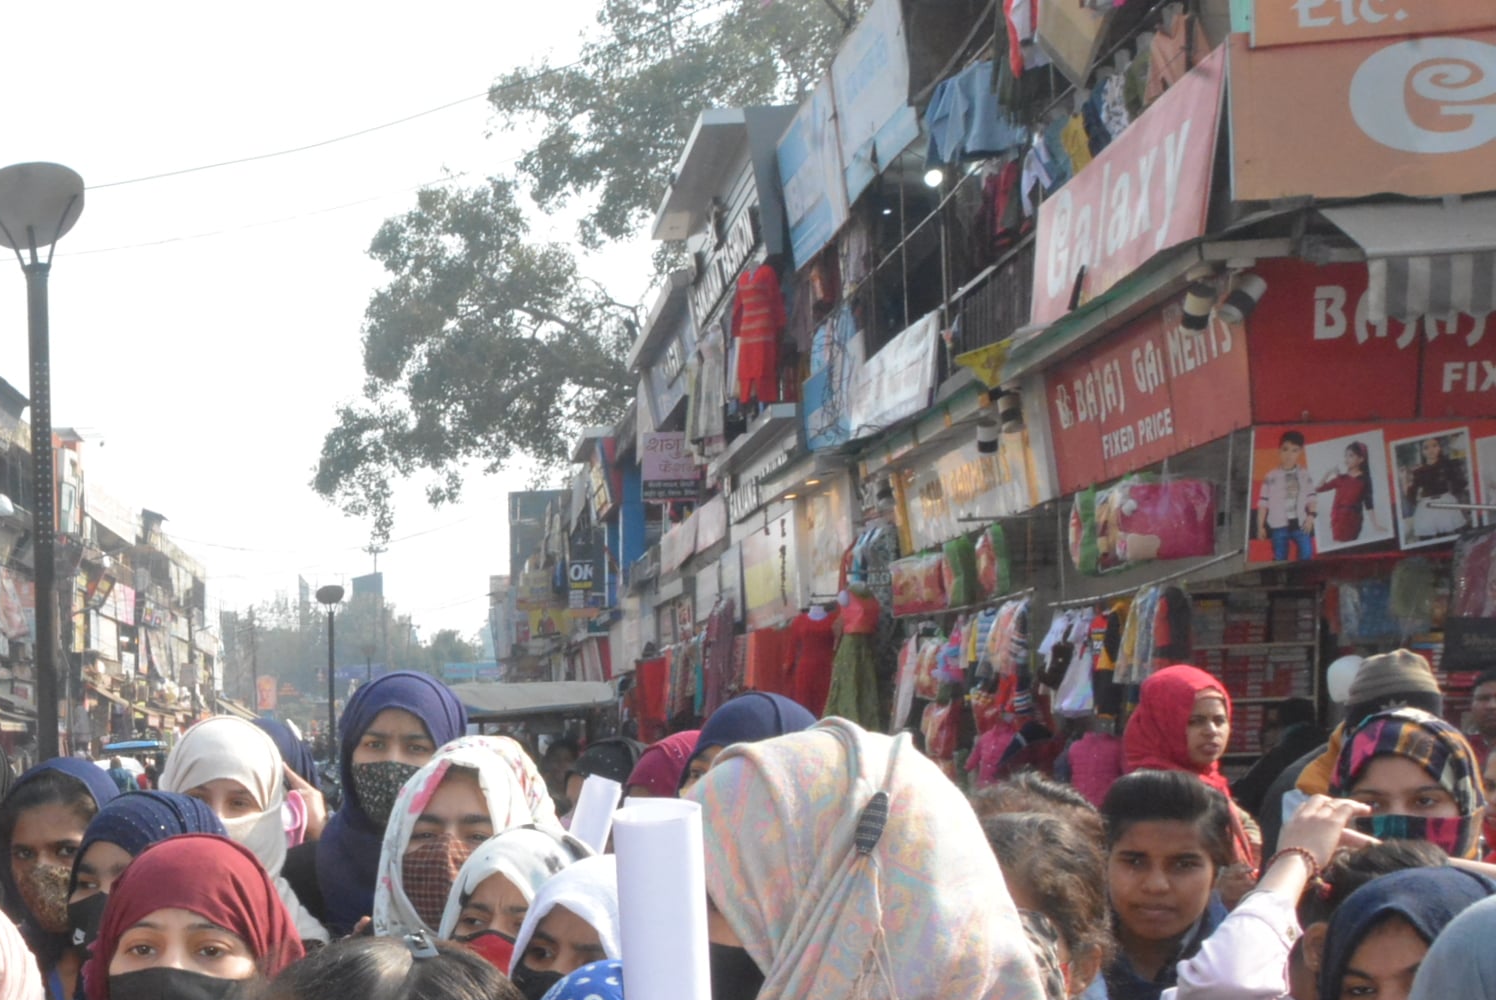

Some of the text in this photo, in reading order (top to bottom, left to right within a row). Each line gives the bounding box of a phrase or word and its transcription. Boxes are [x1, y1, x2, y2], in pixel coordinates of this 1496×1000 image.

[1047, 117, 1193, 299] Galaxy
[1072, 357, 1127, 425] BAJAJ
[1101, 406, 1175, 461] FIXED PRICE
